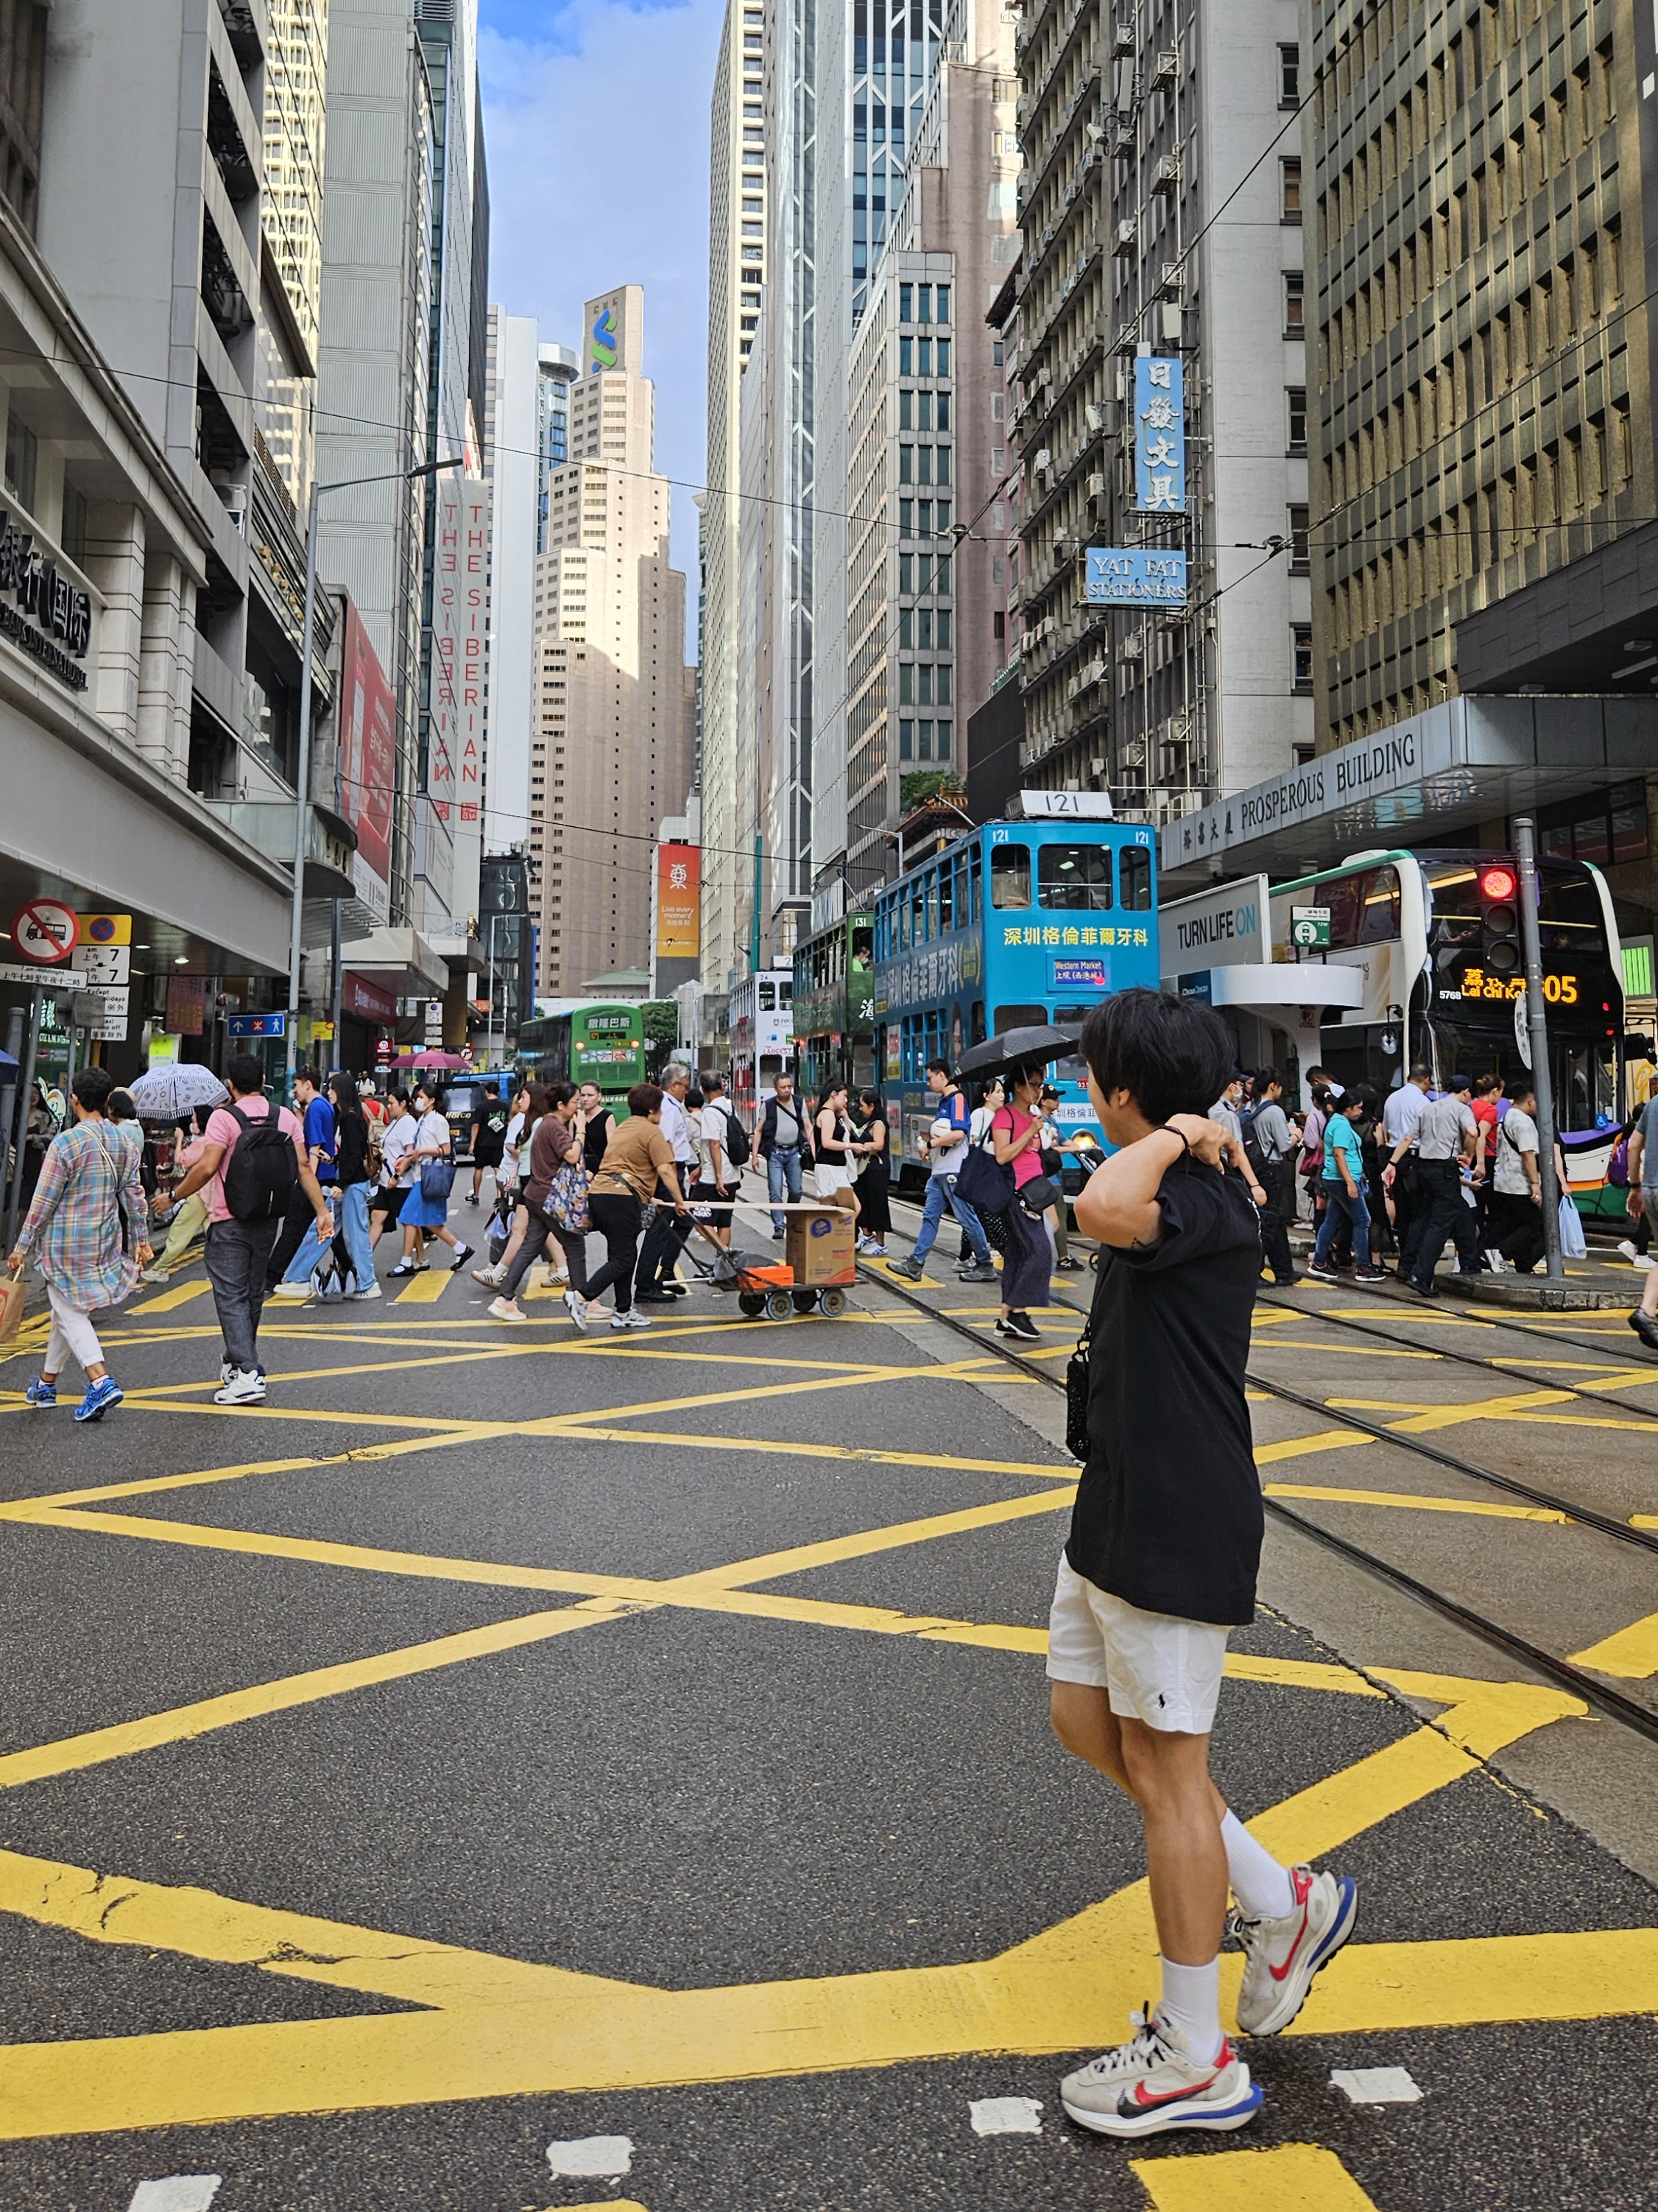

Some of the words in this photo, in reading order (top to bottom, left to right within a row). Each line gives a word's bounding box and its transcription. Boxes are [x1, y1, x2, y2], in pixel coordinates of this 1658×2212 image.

[1140, 360, 1181, 511] 日發文具
[468, 505, 483, 573] THE
[1093, 557, 1134, 576] YAT
[1145, 559, 1182, 578] FAT
[1089, 582, 1187, 600] STATIONERS
[463, 589, 481, 782] SIBERIAN
[1241, 772, 1324, 829] PROSPEROUS
[1336, 734, 1415, 793] BUILDING
[1045, 794, 1079, 812] 121
[992, 829, 1009, 842] 121
[1135, 831, 1149, 845] 121
[855, 917, 867, 927] 131
[1177, 917, 1207, 950] TURN
[1209, 910, 1234, 943] LIFE
[1235, 904, 1256, 937] ON
[1003, 926, 1149, 947] 深圳格倫菲爾牙科
[110, 949, 119, 962] 7
[1056, 961, 1079, 970] Western
[1080, 961, 1102, 970] Market
[109, 969, 119, 982] 7
[1439, 990, 1462, 1000] 5768
[1461, 985, 1481, 997] Lai
[1484, 986, 1503, 998] Chi
[1506, 987, 1528, 999] Ko
[1542, 975, 1578, 1004] 05
[1055, 1107, 1096, 1118] 圳格倫菲
